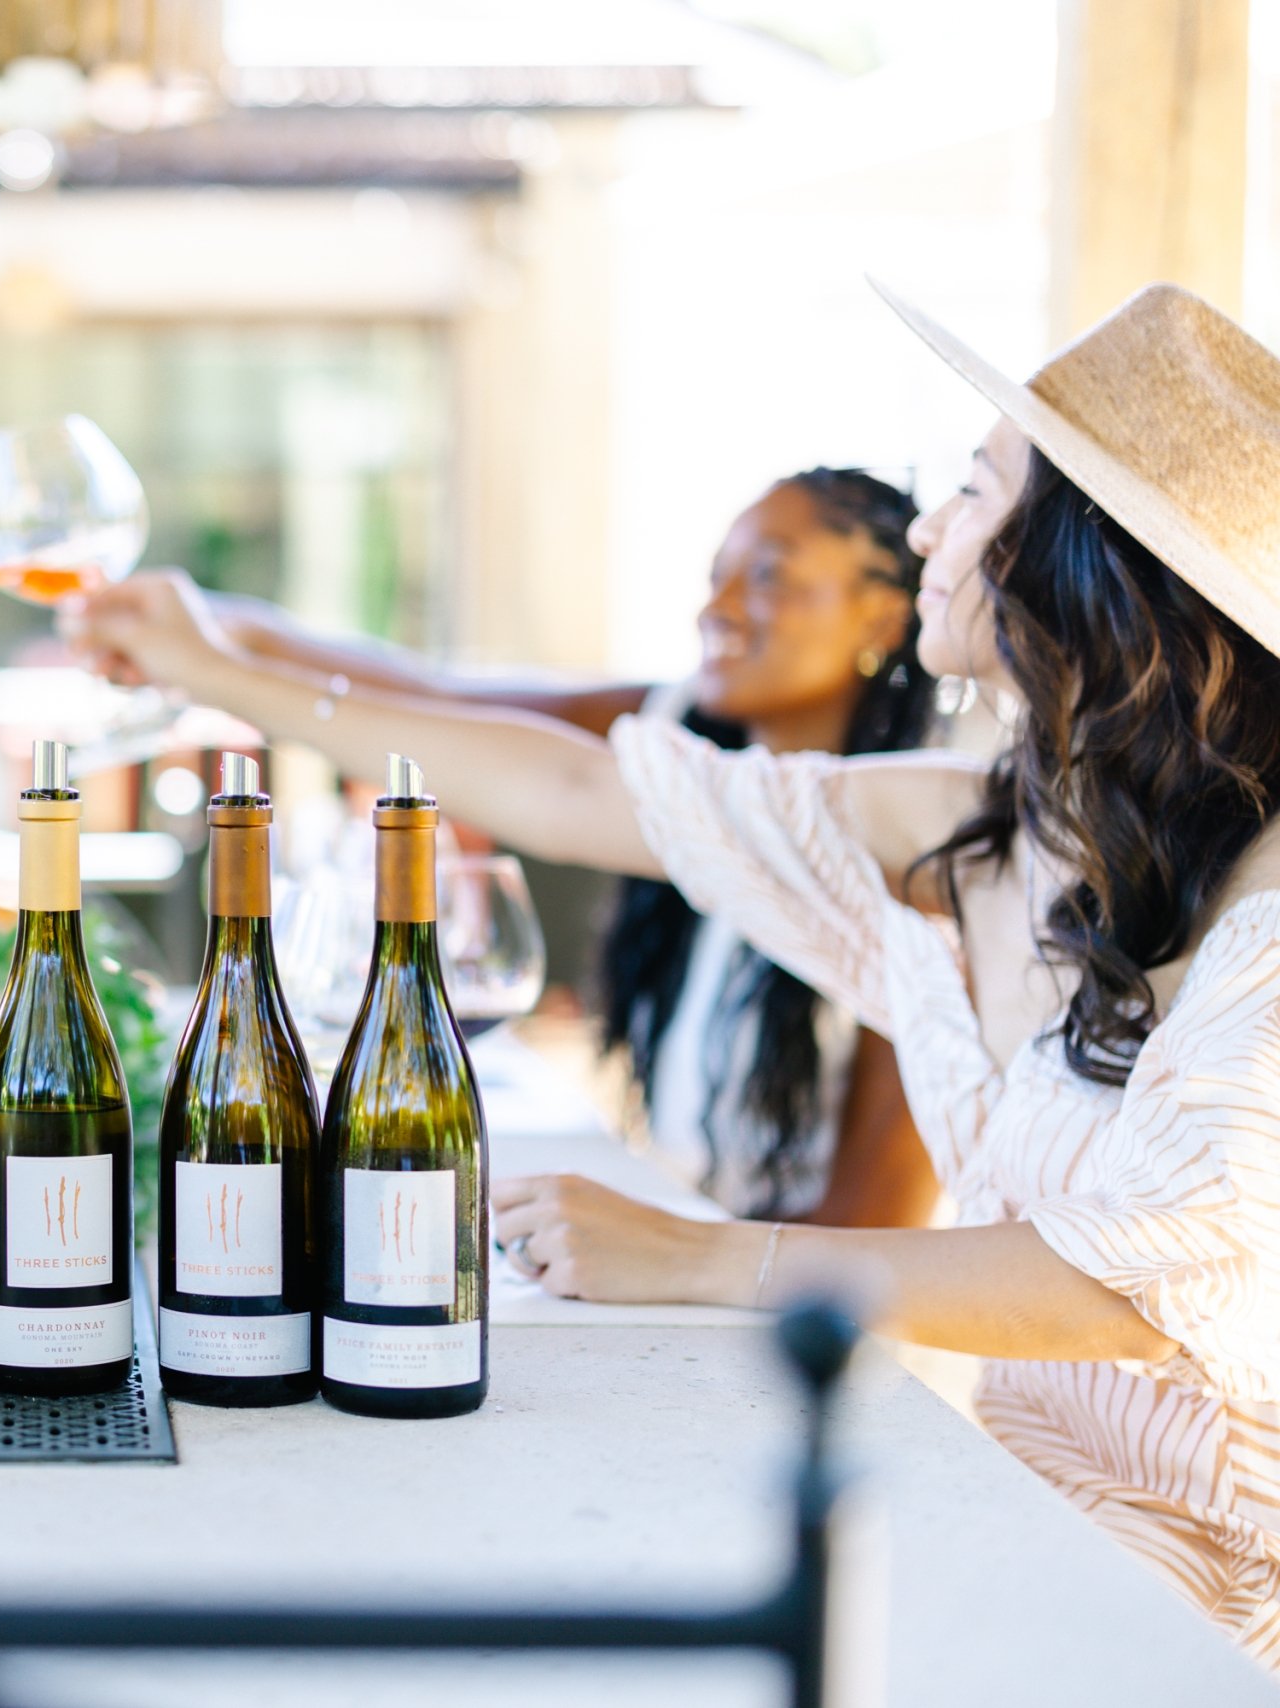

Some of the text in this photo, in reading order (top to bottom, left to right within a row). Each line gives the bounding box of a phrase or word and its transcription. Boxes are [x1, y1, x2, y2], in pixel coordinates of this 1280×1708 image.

[14, 1255, 107, 1268] THREE STICKS
[181, 1263, 274, 1276] THREE STICKS
[400, 1274, 449, 1286] STICKS
[18, 1320, 106, 1332] CHARDONNAY
[21, 1332, 103, 1341] SONOMA MOUNTAIN
[188, 1329, 266, 1340] PINOT NOIR
[194, 1341, 227, 1349] SONOMA
[368, 1341, 412, 1351] FAMILY
[200, 1353, 231, 1361] CROWN
[369, 1353, 399, 1361] PINOT
